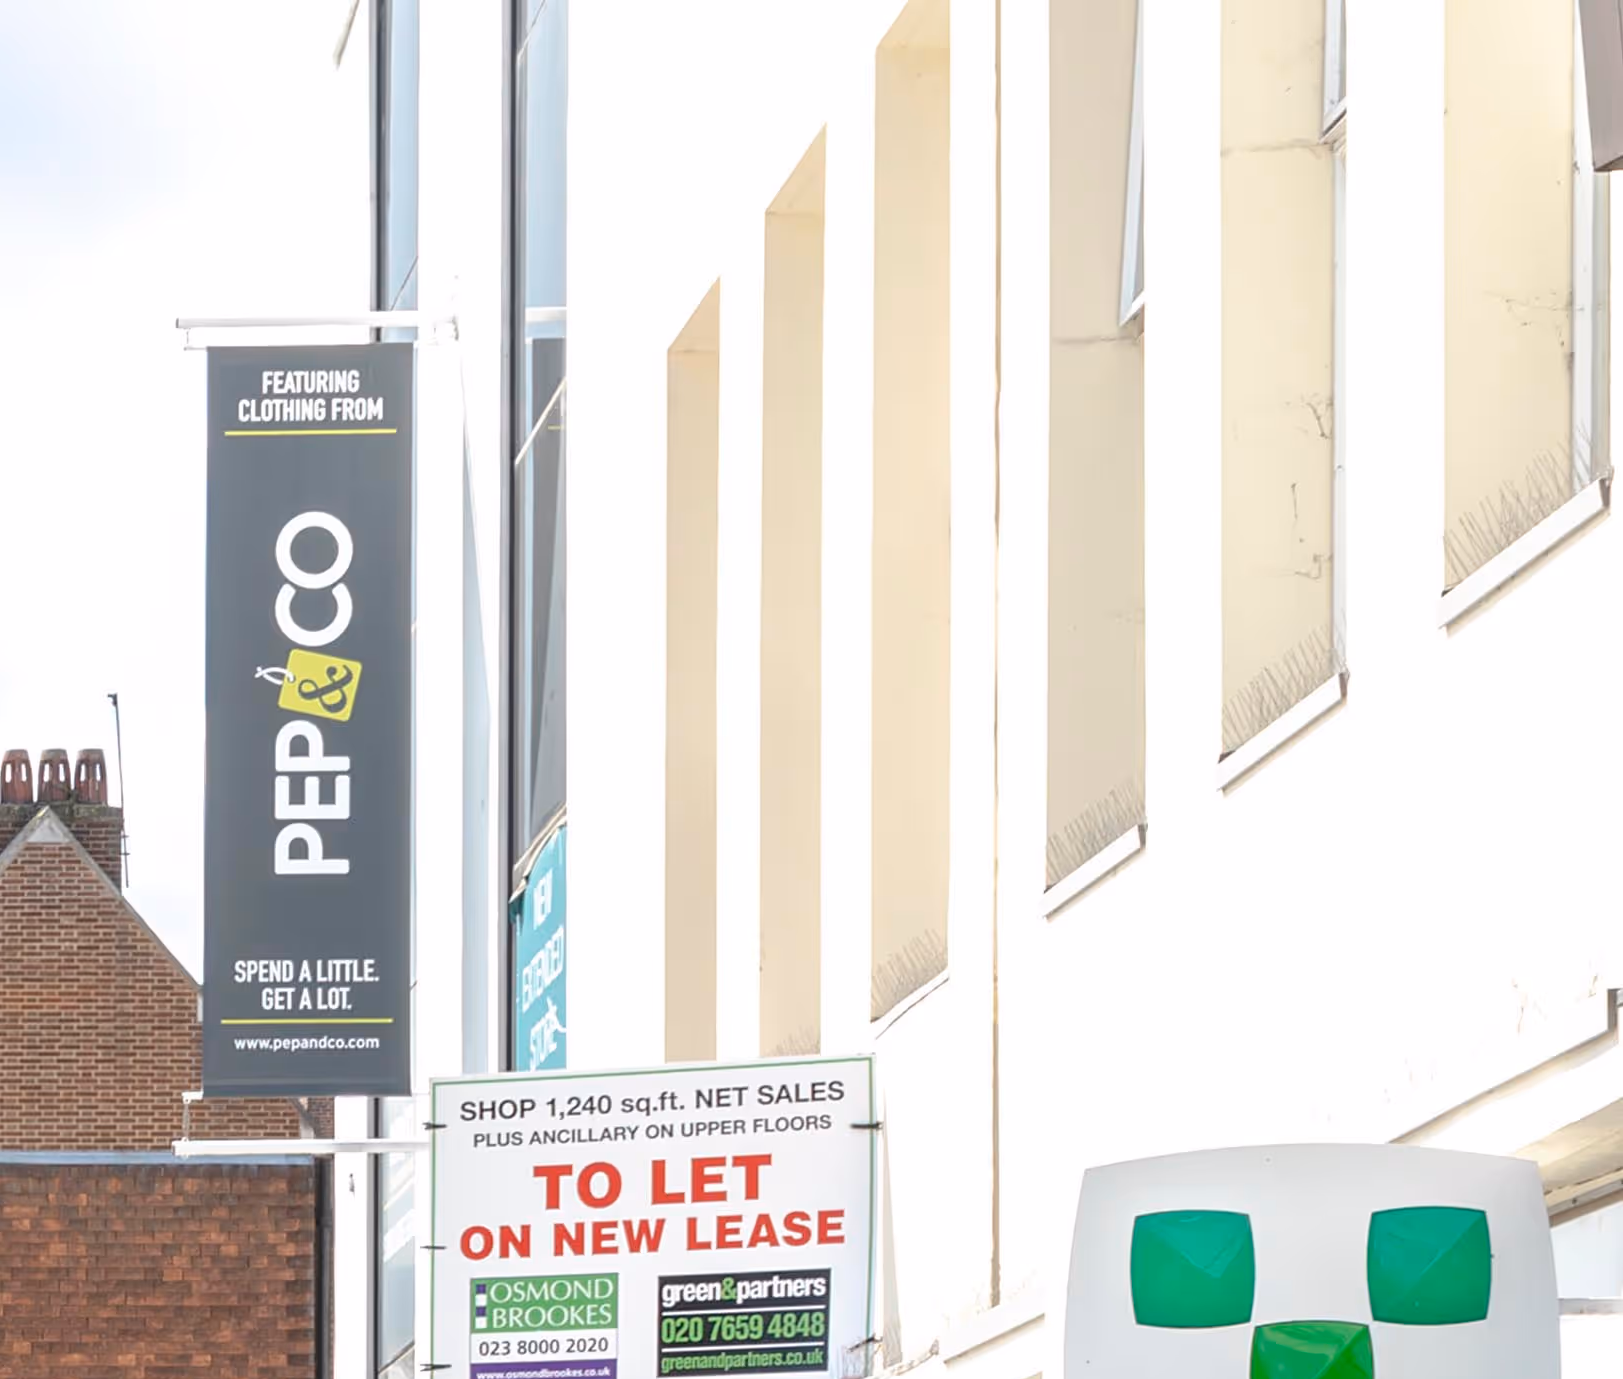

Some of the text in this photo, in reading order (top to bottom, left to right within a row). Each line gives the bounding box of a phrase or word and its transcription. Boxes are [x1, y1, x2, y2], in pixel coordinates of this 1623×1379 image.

[262, 369, 360, 395] FEATURING
[238, 396, 384, 422] CLOTHING FROM
[234, 958, 380, 984] SPEND A LITTLE.
[261, 986, 353, 1012] GET A LOT.
[234, 1034, 380, 1055] www.pepandco.com
[460, 1081, 845, 1121] SHOP 1,240 sq.ft. NET SALES
[473, 1114, 832, 1148] PLUS ANCILLARY ON UPPER FLOORS
[533, 1154, 772, 1210] TO LET
[460, 1209, 846, 1260] ON NEW LEASE
[490, 1278, 614, 1303] OSMOND
[662, 1276, 826, 1308] green&partners
[492, 1304, 613, 1329] BROOKES
[661, 1311, 825, 1344] 020 7659 4848
[479, 1337, 608, 1356] 023 8000 2020
[661, 1350, 824, 1375] greenandpartners.co.uk
